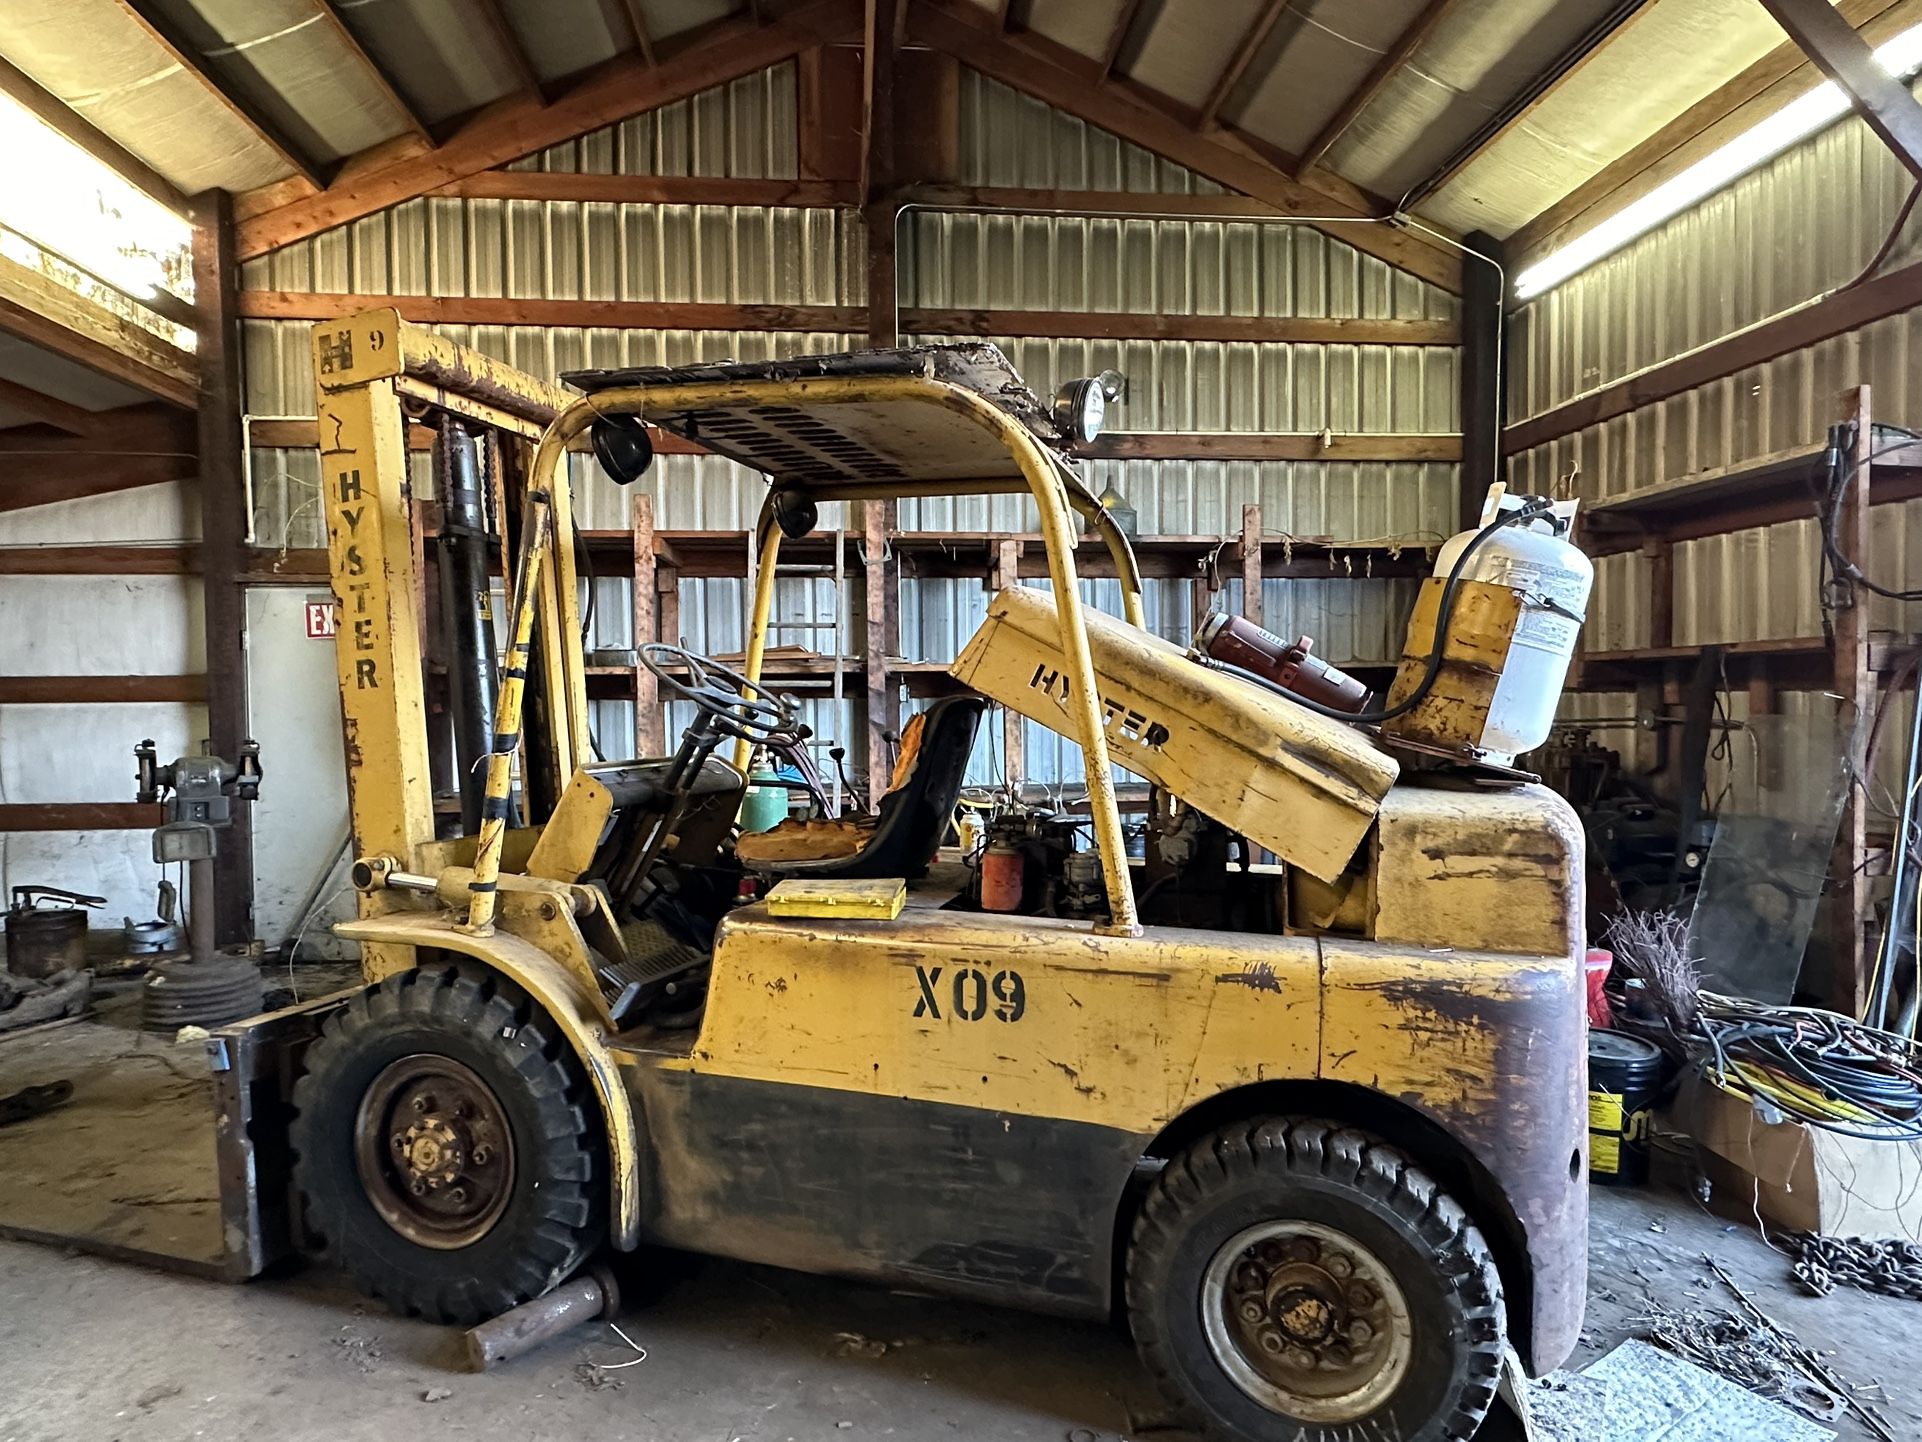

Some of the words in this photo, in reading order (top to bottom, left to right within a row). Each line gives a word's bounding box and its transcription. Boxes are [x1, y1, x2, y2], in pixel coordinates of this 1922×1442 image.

[369, 329, 384, 351] 9
[339, 469, 378, 689] HYSTER
[309, 604, 335, 635] EX
[1029, 663, 1170, 752] HYTER
